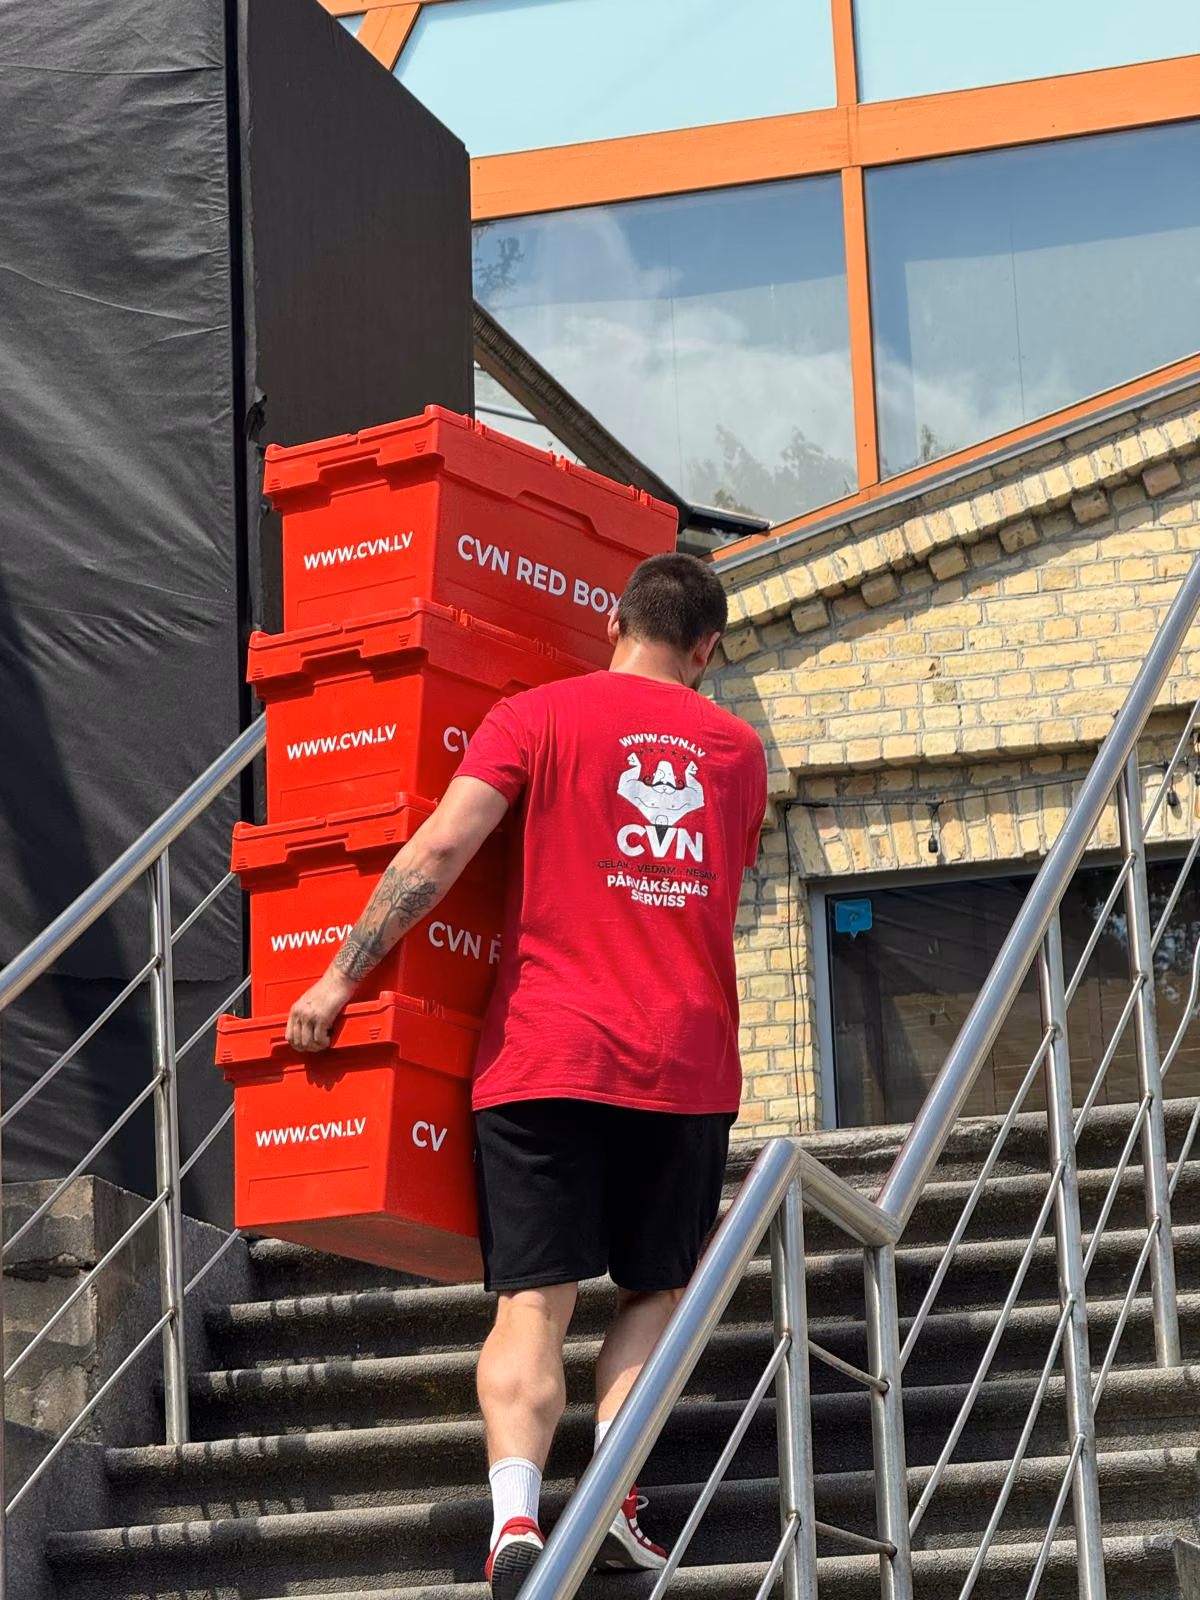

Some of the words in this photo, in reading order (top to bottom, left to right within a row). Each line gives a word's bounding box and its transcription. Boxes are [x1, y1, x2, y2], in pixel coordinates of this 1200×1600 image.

[303, 531, 414, 570] WWW.CVN.LV
[457, 534, 510, 576] CVN
[516, 556, 567, 597] RED
[286, 723, 397, 760] WWW.CVN.LV
[618, 733, 706, 757] WWW.CVN.LV
[616, 823, 704, 863] CVN
[637, 863, 676, 874] VEDAM
[631, 889, 686, 908] SERVISS
[428, 921, 482, 960] CVN
[255, 1116, 367, 1148] WWW.CVN.LV
